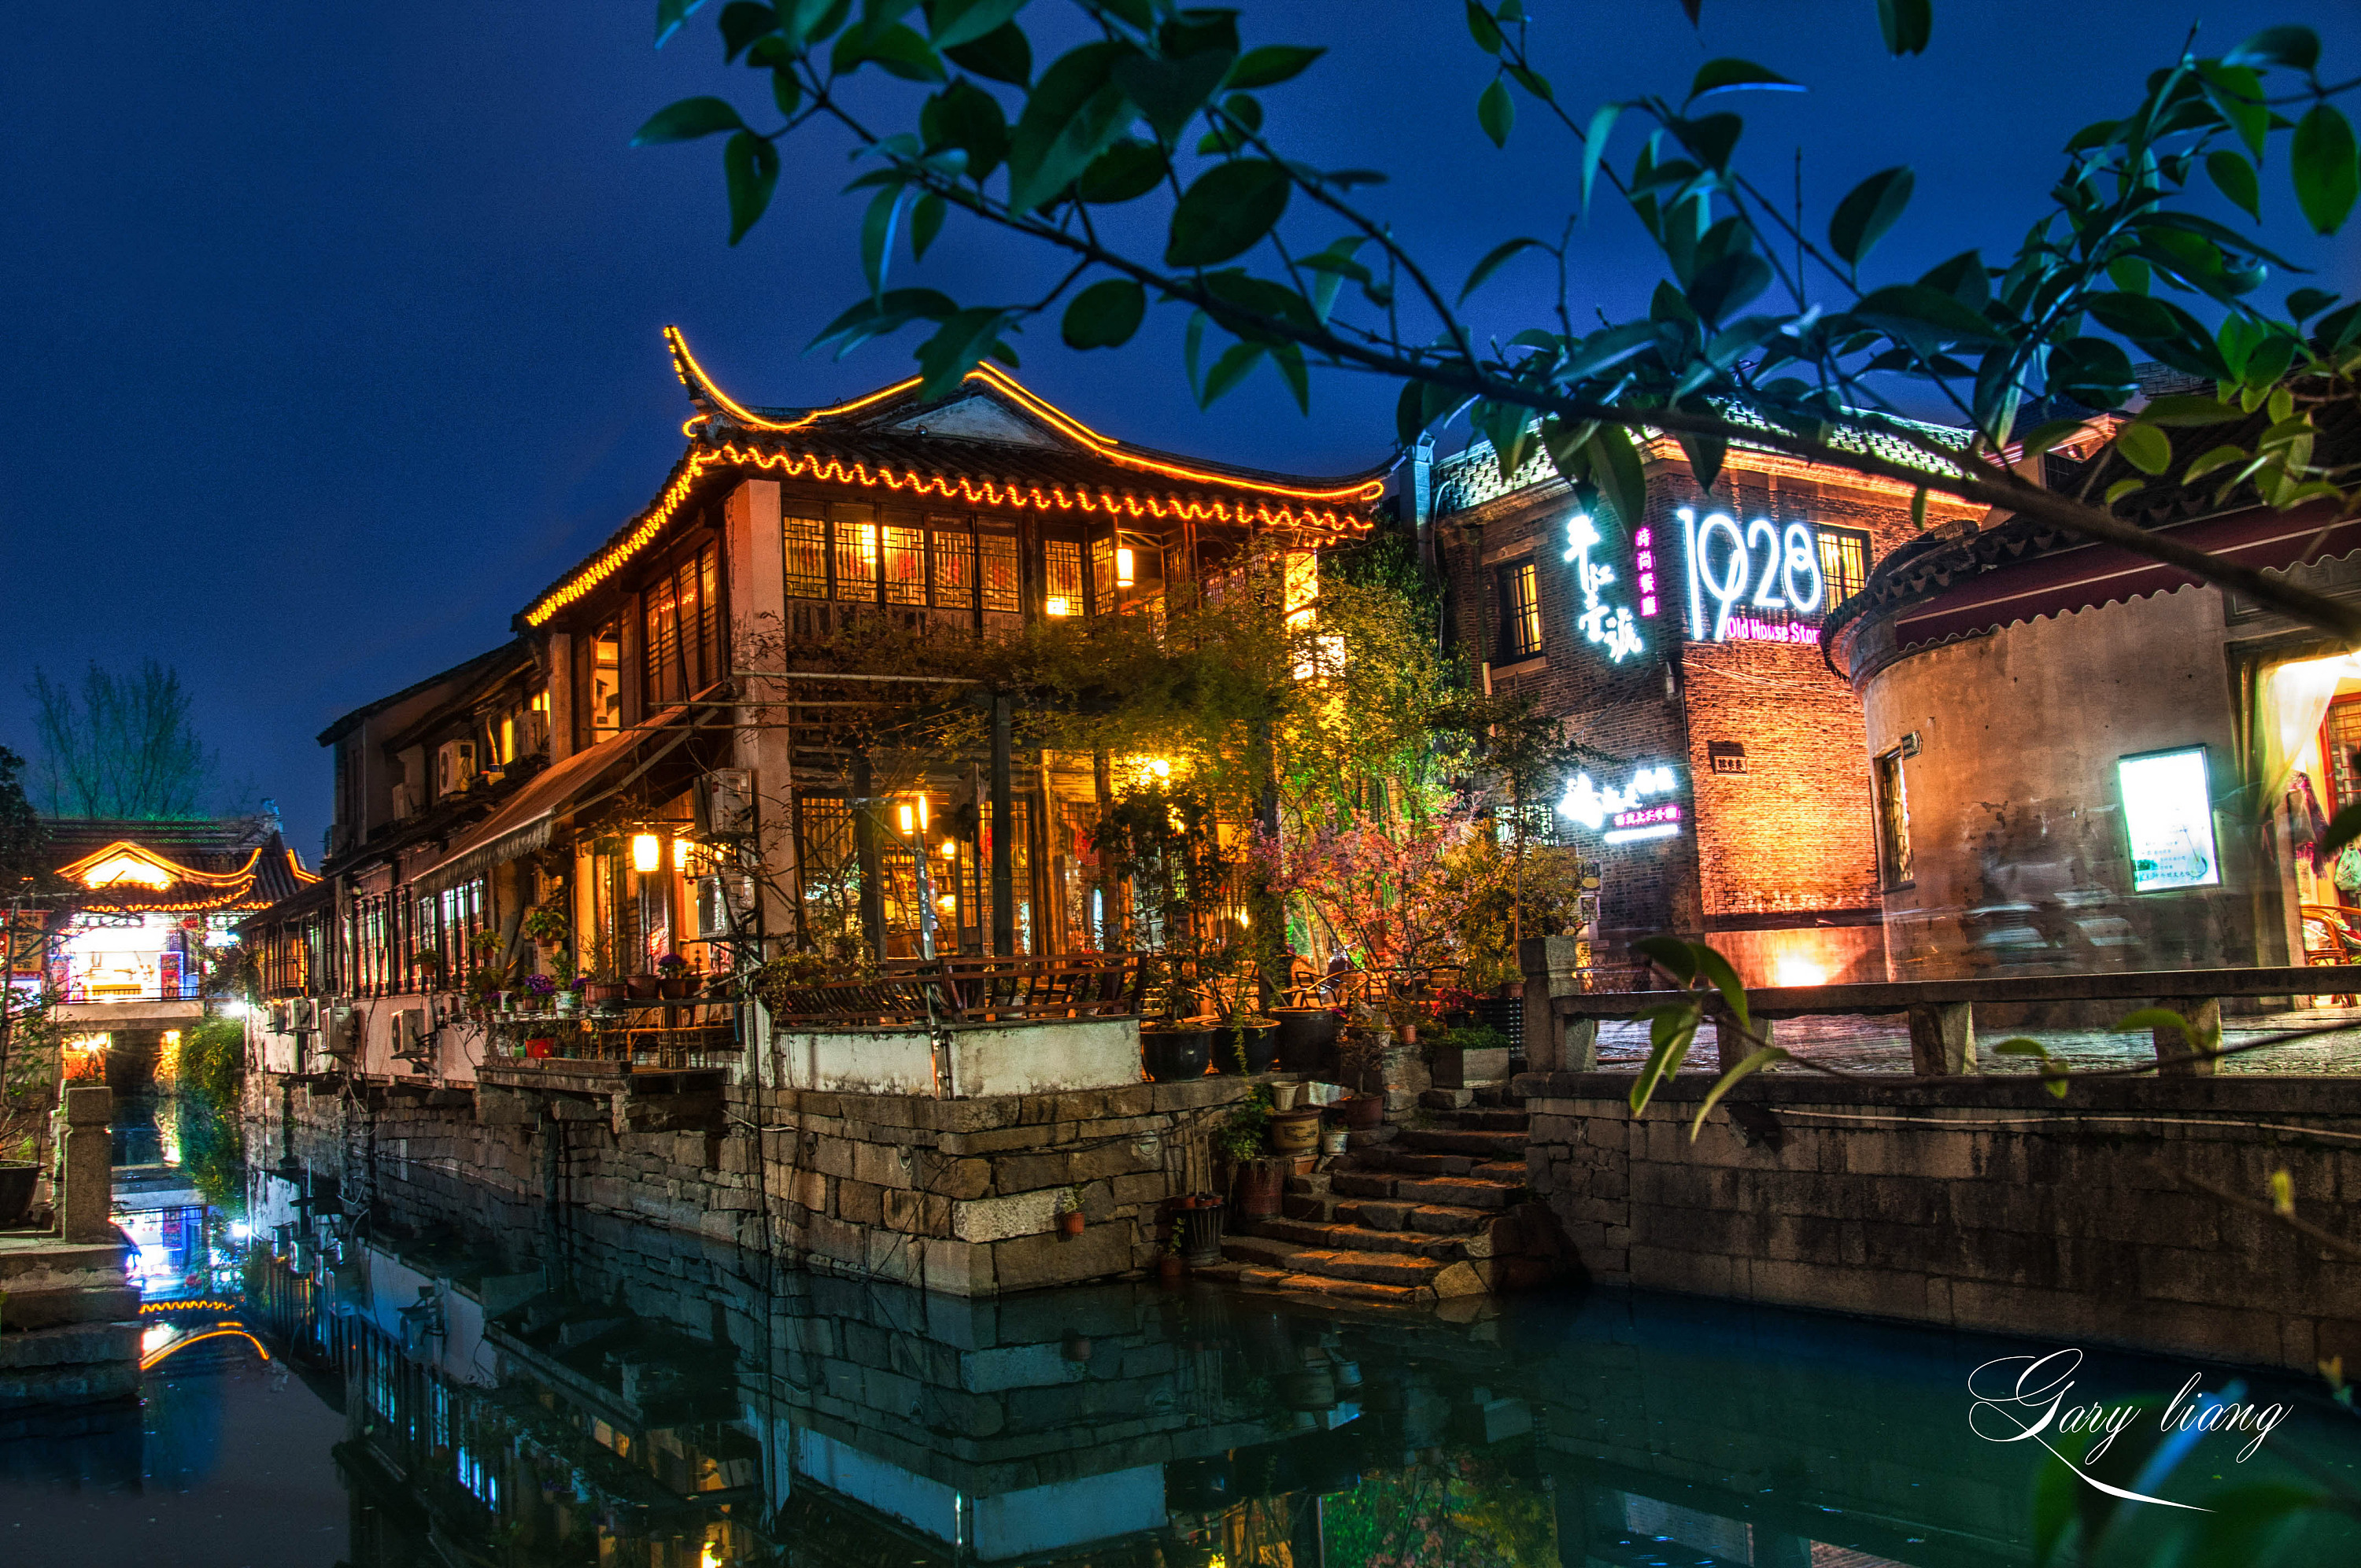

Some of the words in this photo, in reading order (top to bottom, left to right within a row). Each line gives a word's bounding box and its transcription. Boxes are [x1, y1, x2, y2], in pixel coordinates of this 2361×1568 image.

[1677, 509, 1821, 642] 1928
[1727, 617, 1750, 640] Old
[1749, 618, 1790, 642] House
[1789, 622, 1821, 644] Stor
